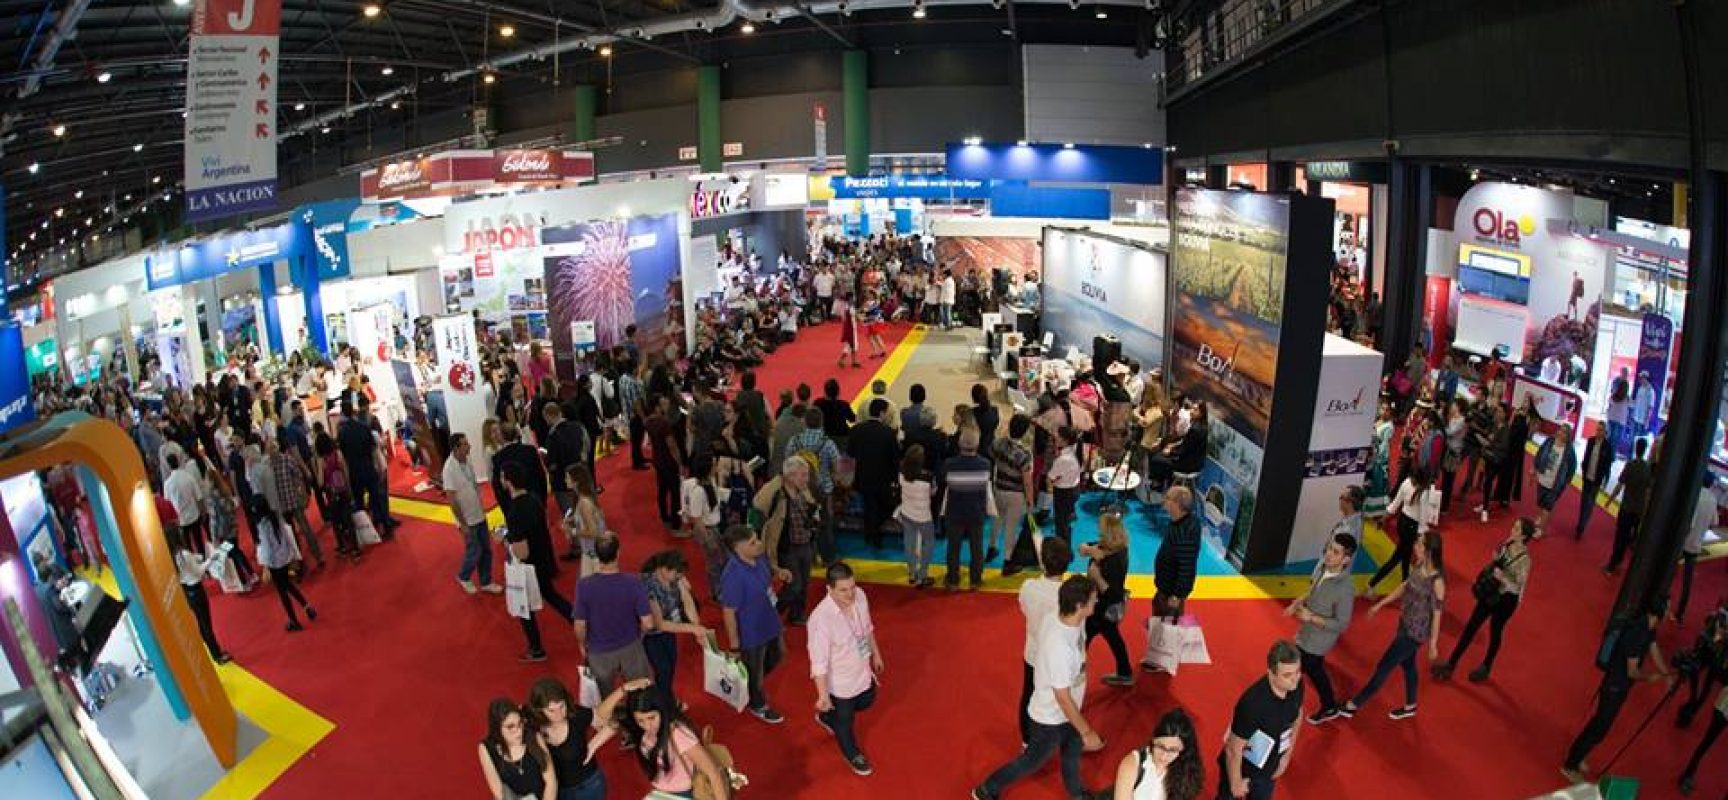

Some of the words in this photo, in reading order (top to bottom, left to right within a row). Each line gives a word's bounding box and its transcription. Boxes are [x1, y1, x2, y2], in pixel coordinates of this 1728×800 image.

[228, 0, 254, 31] J
[202, 163, 251, 179] Argentina
[188, 195, 211, 211] LA
[215, 184, 275, 207] NACION
[1474, 207, 1521, 242] Ola
[1081, 280, 1107, 303] BOLIVIA
